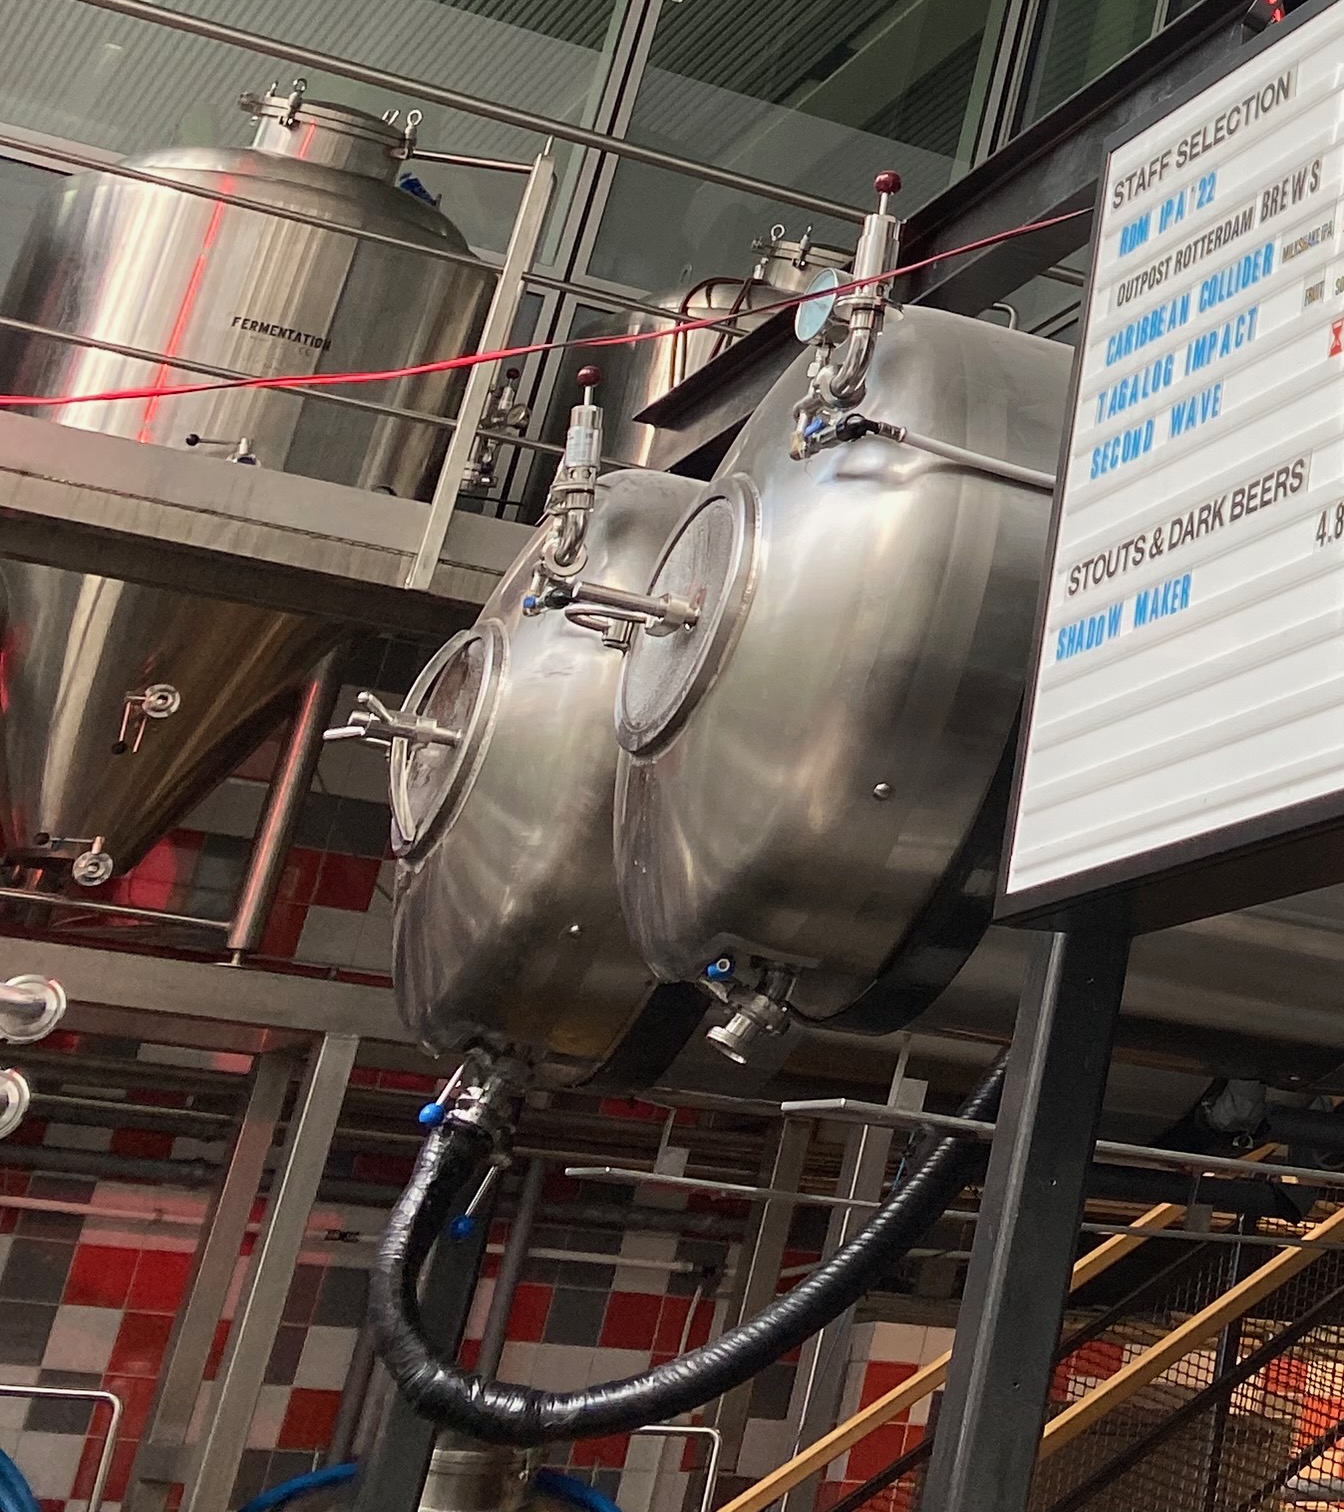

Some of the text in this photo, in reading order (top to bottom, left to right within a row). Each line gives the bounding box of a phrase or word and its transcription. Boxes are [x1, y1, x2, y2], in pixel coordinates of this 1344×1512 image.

[1113, 71, 1292, 209] STAFF SELECTION
[1117, 159, 1321, 306] OUTPOST ROTTERDAM BREWS
[1119, 213, 1151, 257] RDM
[1158, 190, 1186, 235] IPA
[231, 316, 332, 351] FERMENTATION
[1097, 352, 1175, 424] TAGALOG
[1185, 304, 1259, 377] IMPACT
[1106, 292, 1192, 367] CARIBBEAN
[1199, 242, 1274, 313] COLLIDER
[1090, 417, 1155, 480] SECOND
[1170, 382, 1222, 438] WAVE
[1068, 458, 1306, 596] STOUTS & DARK BEERS
[1055, 602, 1124, 662] SHADOW
[1133, 573, 1193, 630] MAKER
